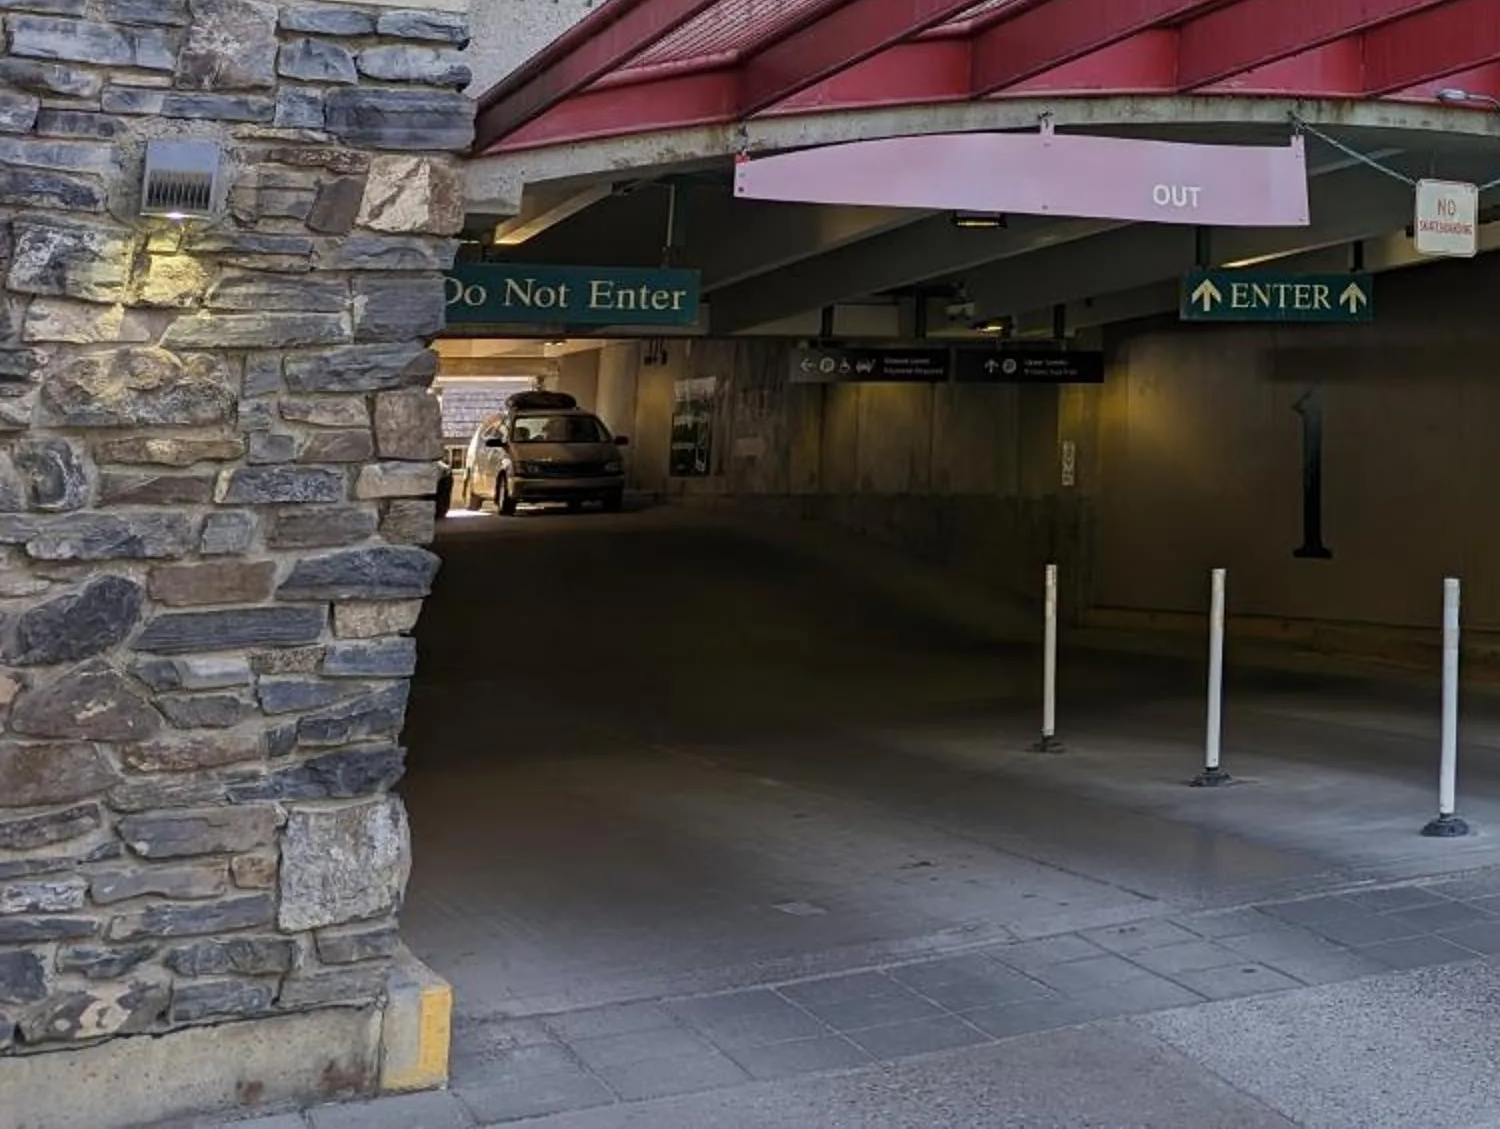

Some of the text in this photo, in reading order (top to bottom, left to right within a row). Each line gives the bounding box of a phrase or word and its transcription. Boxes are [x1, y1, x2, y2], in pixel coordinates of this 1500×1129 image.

[1152, 184, 1202, 208] OUT
[1437, 198, 1456, 216] NO
[502, 277, 570, 309] Not
[588, 280, 687, 311] Enter
[1230, 282, 1332, 310] ENTER
